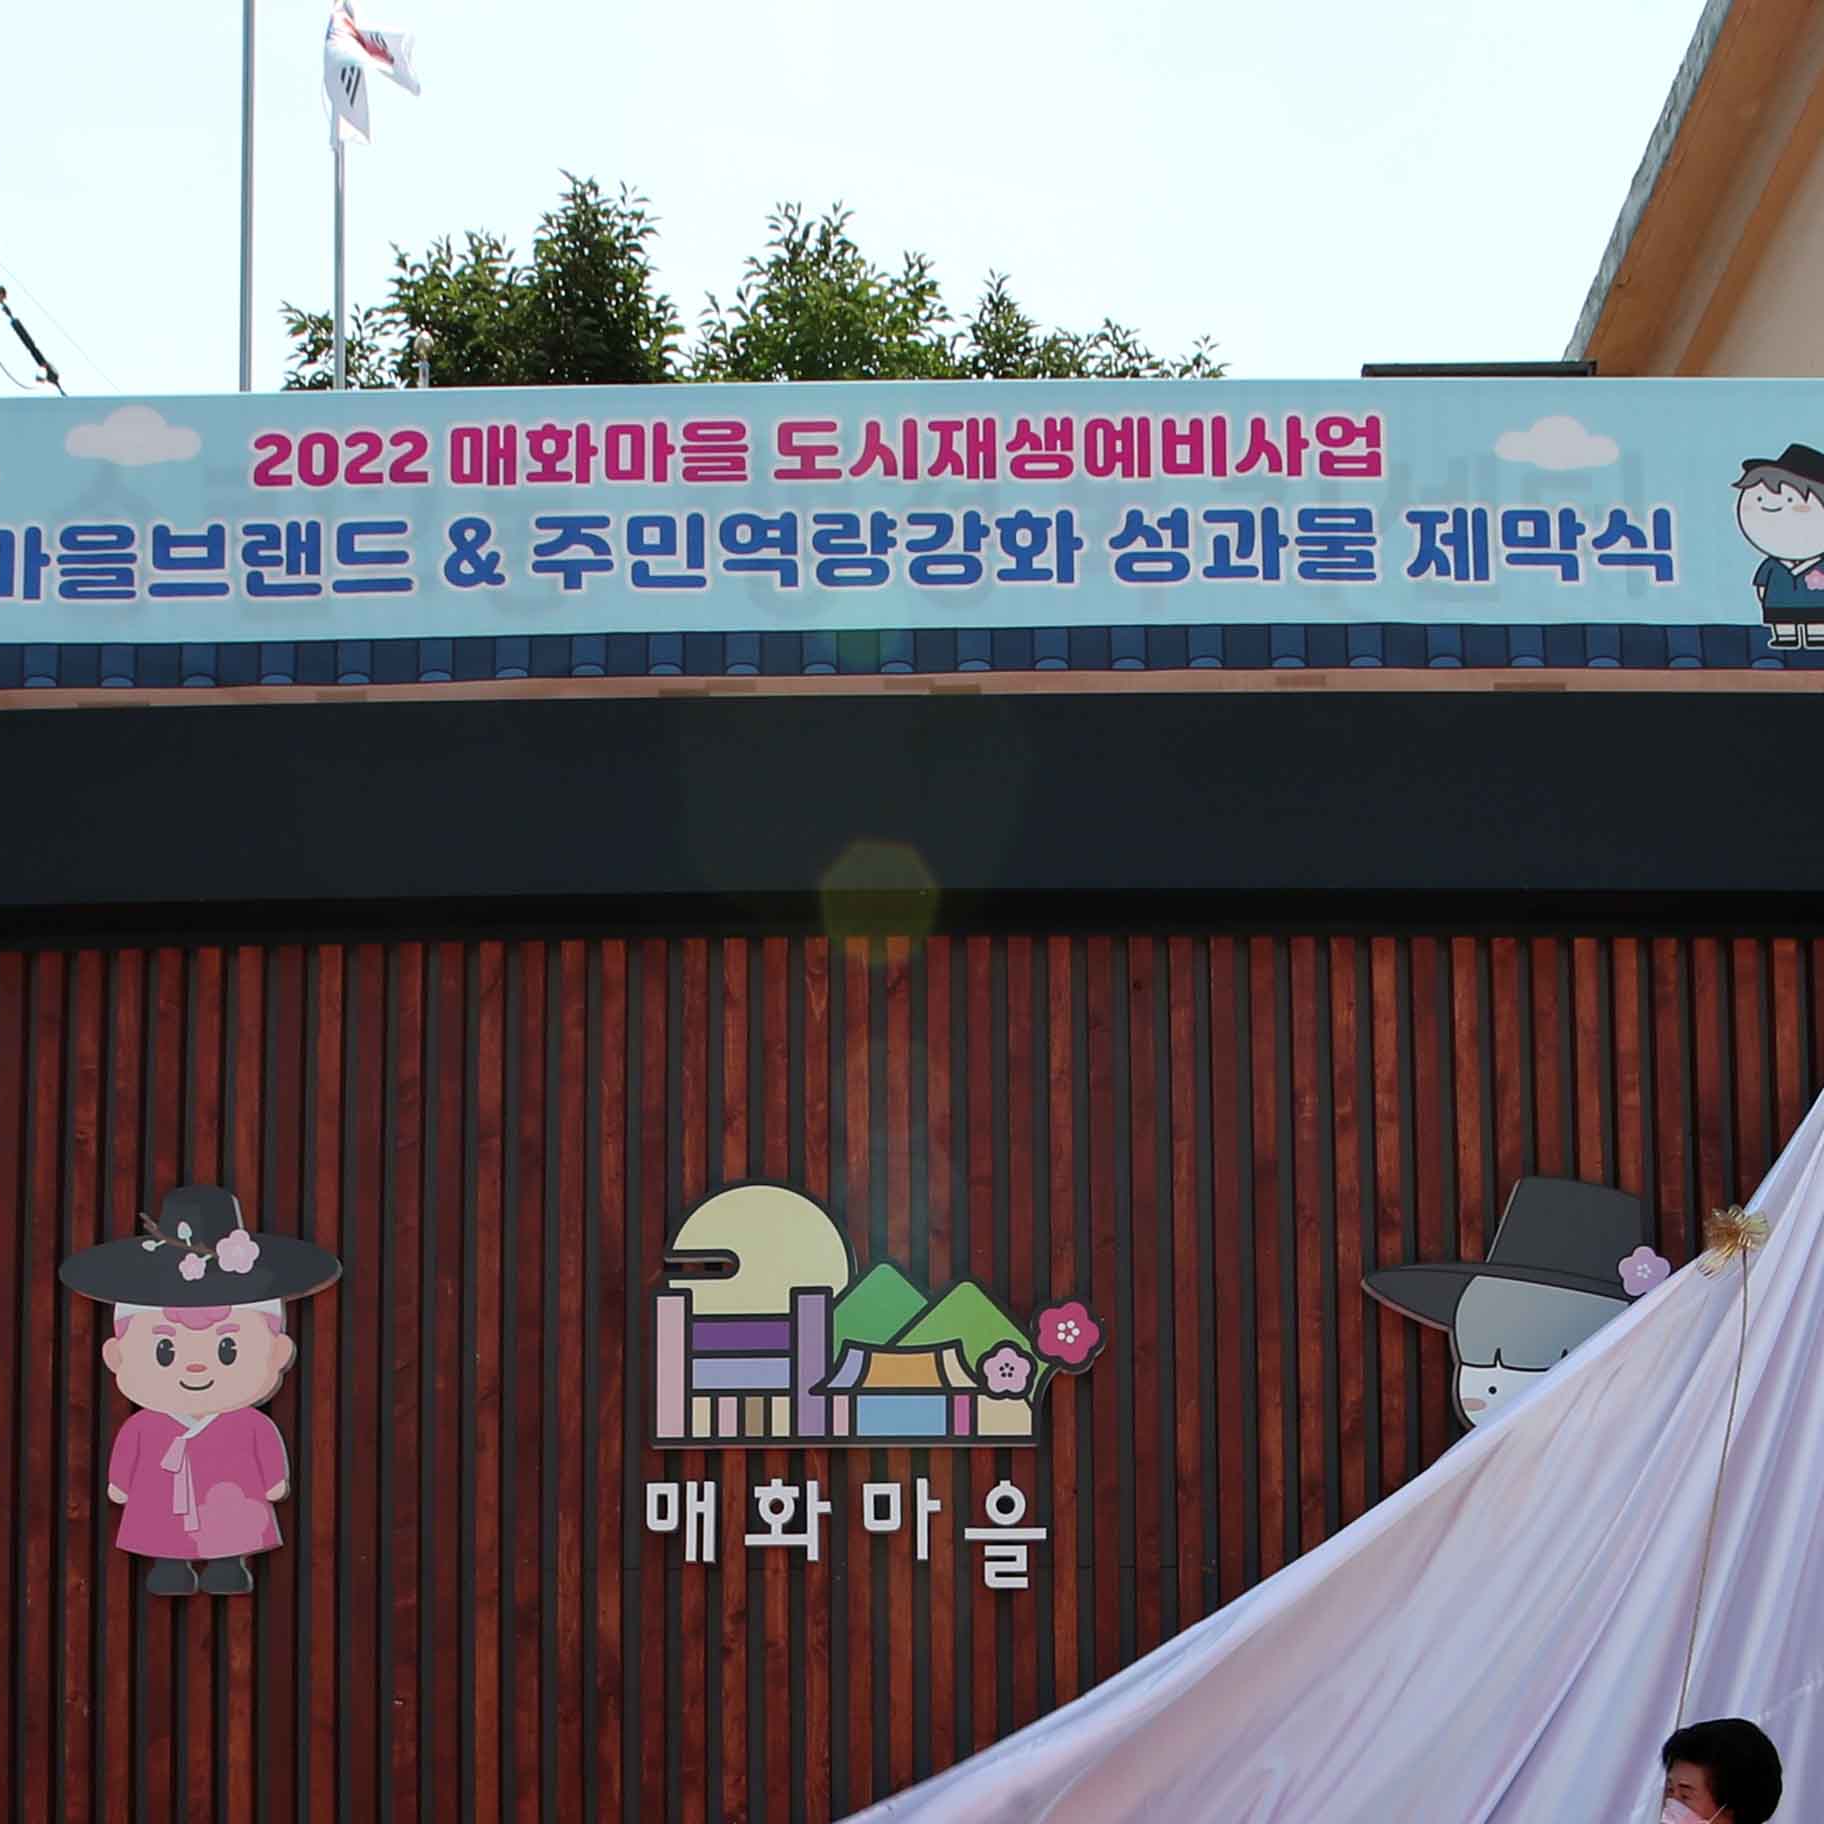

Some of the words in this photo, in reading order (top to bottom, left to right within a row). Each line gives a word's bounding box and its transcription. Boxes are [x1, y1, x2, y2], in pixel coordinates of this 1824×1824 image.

[253, 430, 430, 488] 2022
[450, 421, 750, 487] 매화마을
[773, 415, 1384, 482] 도시재생예비사업
[443, 516, 506, 588] &
[531, 509, 1086, 592] 주민역량강화
[1109, 506, 1380, 584] 성과물
[1406, 507, 1676, 582] 제막식
[646, 1478, 1048, 1590] 매화마을
